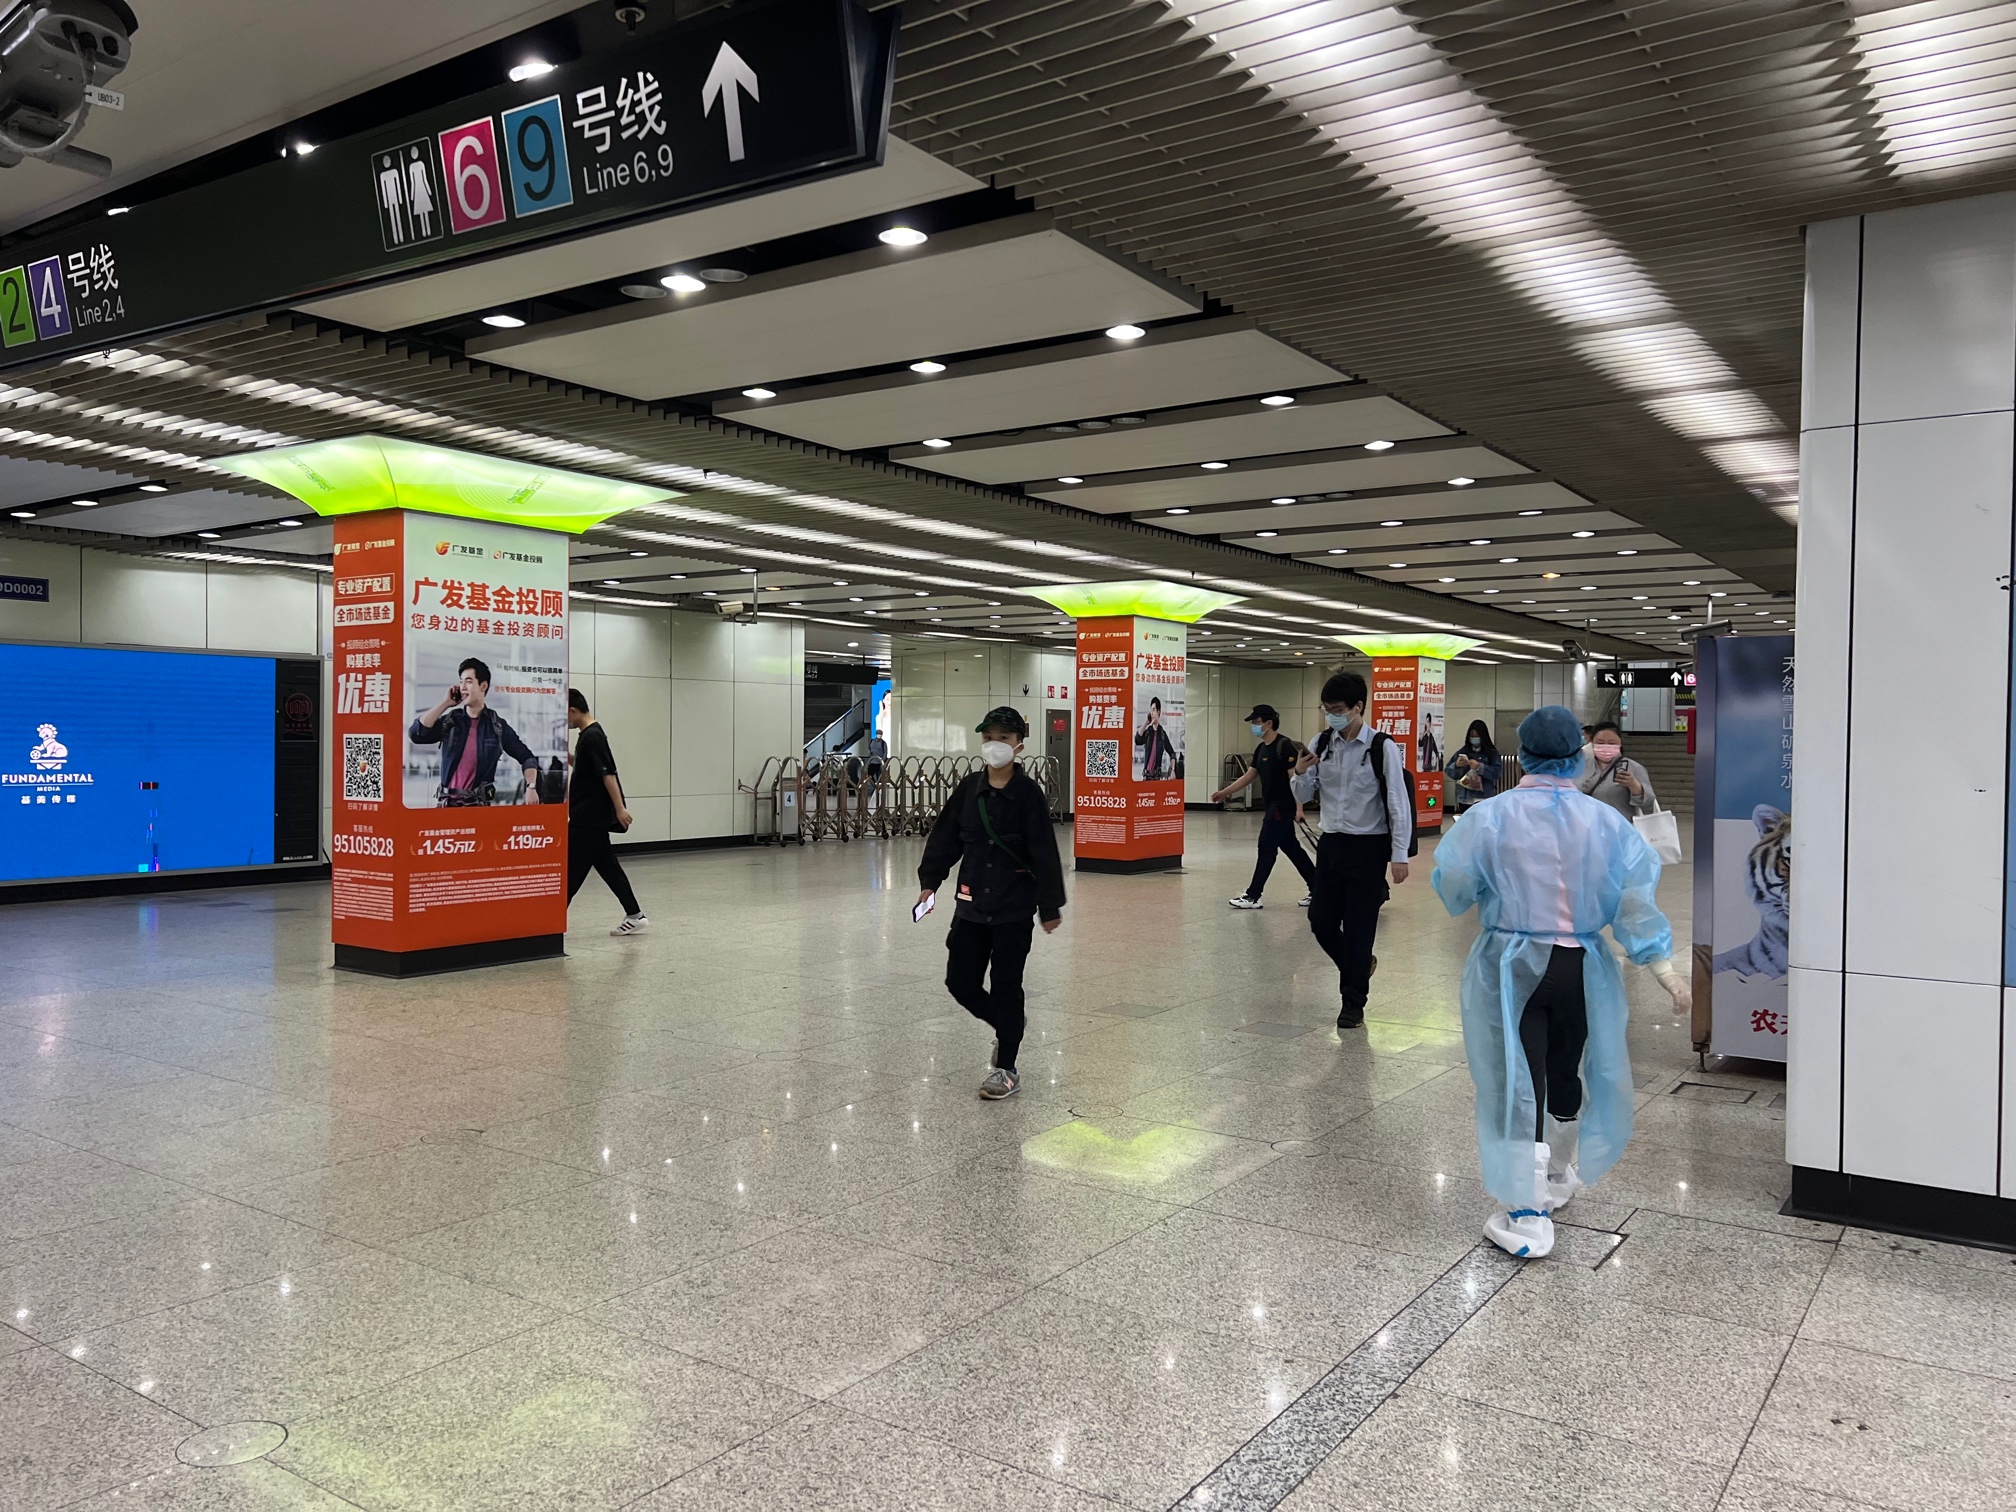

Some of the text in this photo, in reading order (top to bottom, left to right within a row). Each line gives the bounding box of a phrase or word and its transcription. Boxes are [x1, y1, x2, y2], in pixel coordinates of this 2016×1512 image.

[453, 72, 667, 220] 6 9 号线
[2, 243, 119, 334] 2 4 号线
[452, 544, 543, 564] 广发基金 广发基金投顾
[337, 576, 391, 595] 专业资产配置
[412, 577, 564, 618] 广发基金投顾
[337, 605, 391, 623] 全市场选基金
[411, 612, 564, 640] 您身边的基金投资顾问
[1136, 653, 1184, 672] 广发基金投顾
[1081, 669, 1126, 677] 全市场选基金
[1687, 673, 1695, 683] 6
[337, 671, 391, 714] 优惠
[1081, 705, 1125, 728] 优惠
[1376, 718, 1411, 735] 优惠
[2, 774, 94, 783] FUNDAMENTAL
[787, 795, 791, 803] 4
[1077, 796, 1126, 808] 95105828
[334, 833, 394, 857] 95105828
